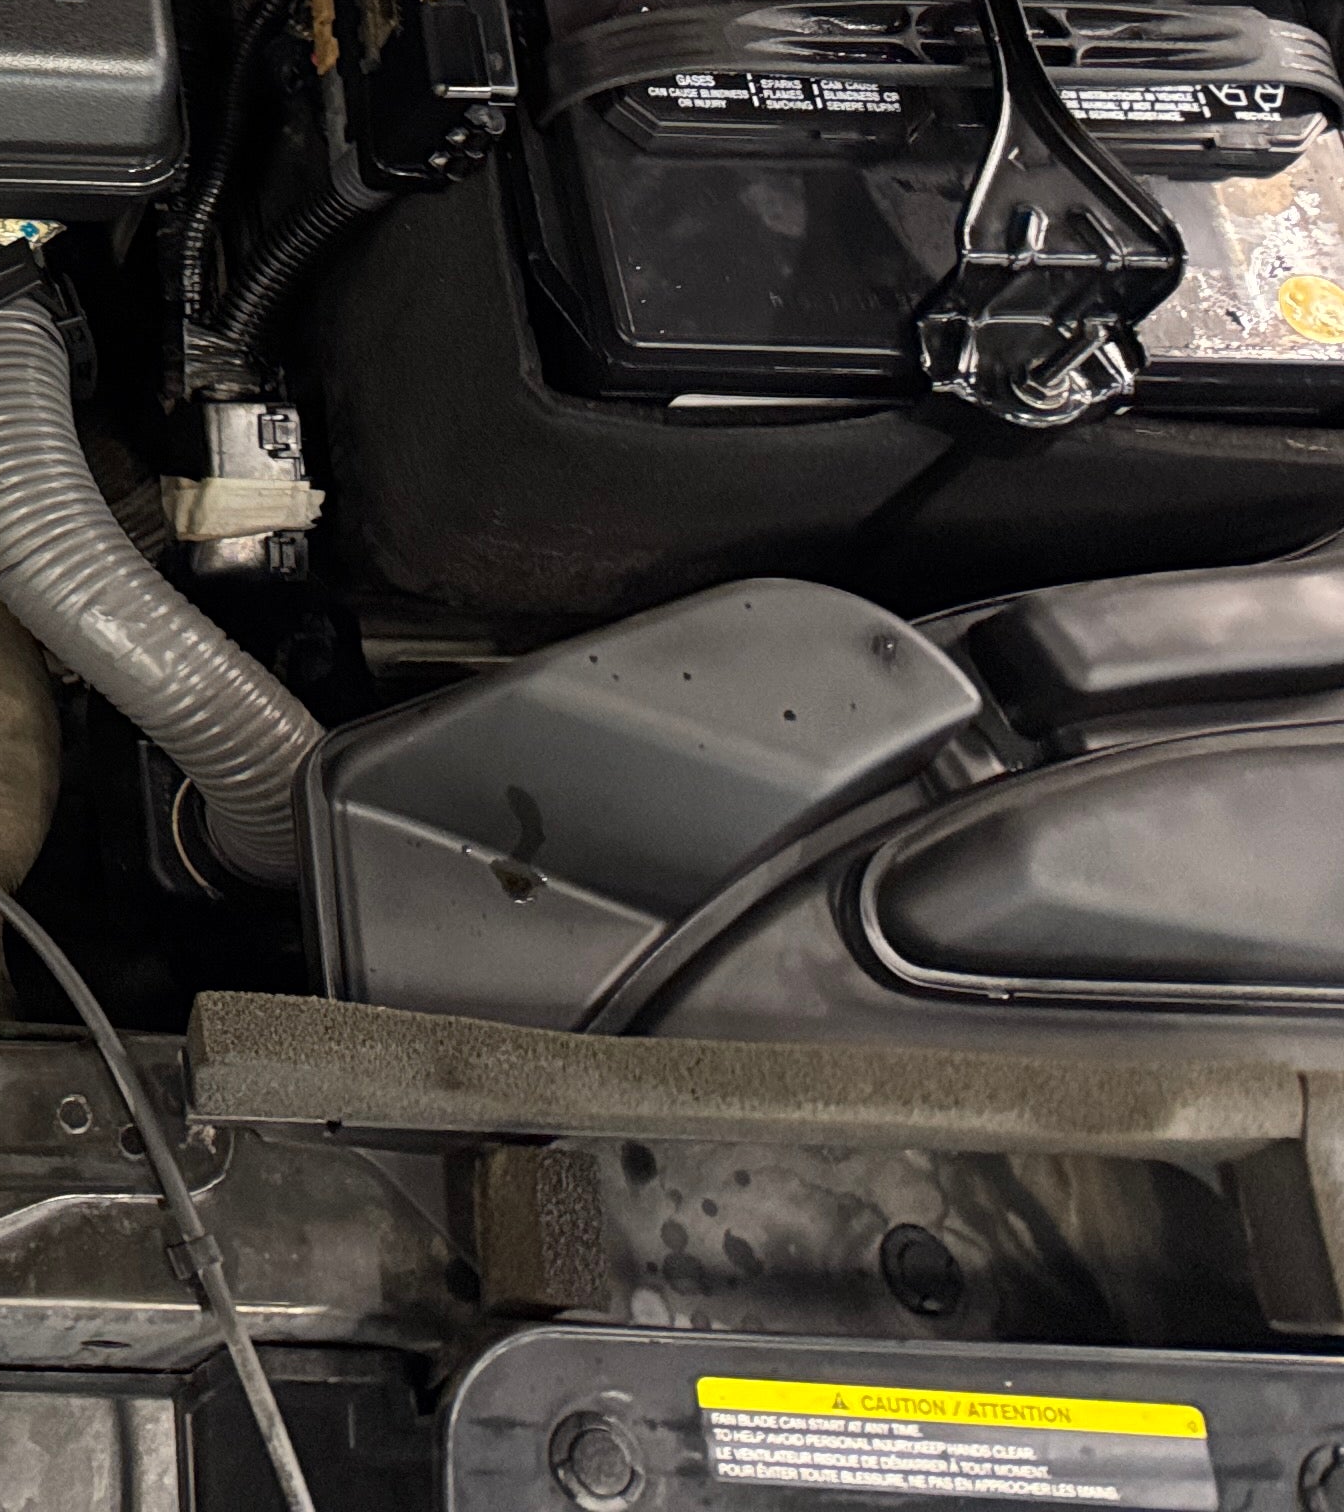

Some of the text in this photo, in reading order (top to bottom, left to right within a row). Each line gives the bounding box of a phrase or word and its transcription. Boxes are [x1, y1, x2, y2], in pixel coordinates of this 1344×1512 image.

[675, 75, 715, 86] GASES
[761, 79, 802, 89] SPARKS
[820, 80, 843, 90] CAN
[648, 87, 749, 99] CAN CAUSE BLINDNESS
[763, 89, 804, 100] FLAMES
[823, 91, 880, 101] BLINDNESS
[678, 99, 727, 109] OR INJURY
[766, 100, 813, 110] SMOKING
[826, 101, 865, 111] SEVERE
[1235, 111, 1281, 121] RECYCLE
[861, 1394, 1072, 1424] CAUTION / ATTENTION
[711, 1412, 737, 1426] FAN
[737, 1414, 778, 1429] BLADE
[779, 1416, 807, 1431] CAN
[808, 1418, 846, 1432] START
[848, 1420, 862, 1433] AT
[864, 1421, 890, 1434] ANY
[713, 1428, 733, 1442] TO
[733, 1430, 765, 1443] HELP
[767, 1433, 804, 1447] AVOID
[805, 1434, 872, 1450] PERSONAL
[947, 1443, 992, 1458] HANDS
[715, 1446, 733, 1460] LE
[734, 1448, 812, 1465] VENTILATEUR
[813, 1451, 859, 1467] RISQUE
[861, 1454, 879, 1468] DE
[880, 1453, 949, 1473] DÉMARRER
[960, 1461, 992, 1476] TOUT
[718, 1462, 755, 1477] POUR
[757, 1462, 798, 1480] ÉVITER
[800, 1467, 838, 1483] TOUTE
[908, 1474, 927, 1489] NE
[929, 1475, 953, 1490] PAS
[954, 1477, 973, 1492] EN
[975, 1478, 1051, 1496] APPROCHER
[1052, 1483, 1075, 1498] LES
